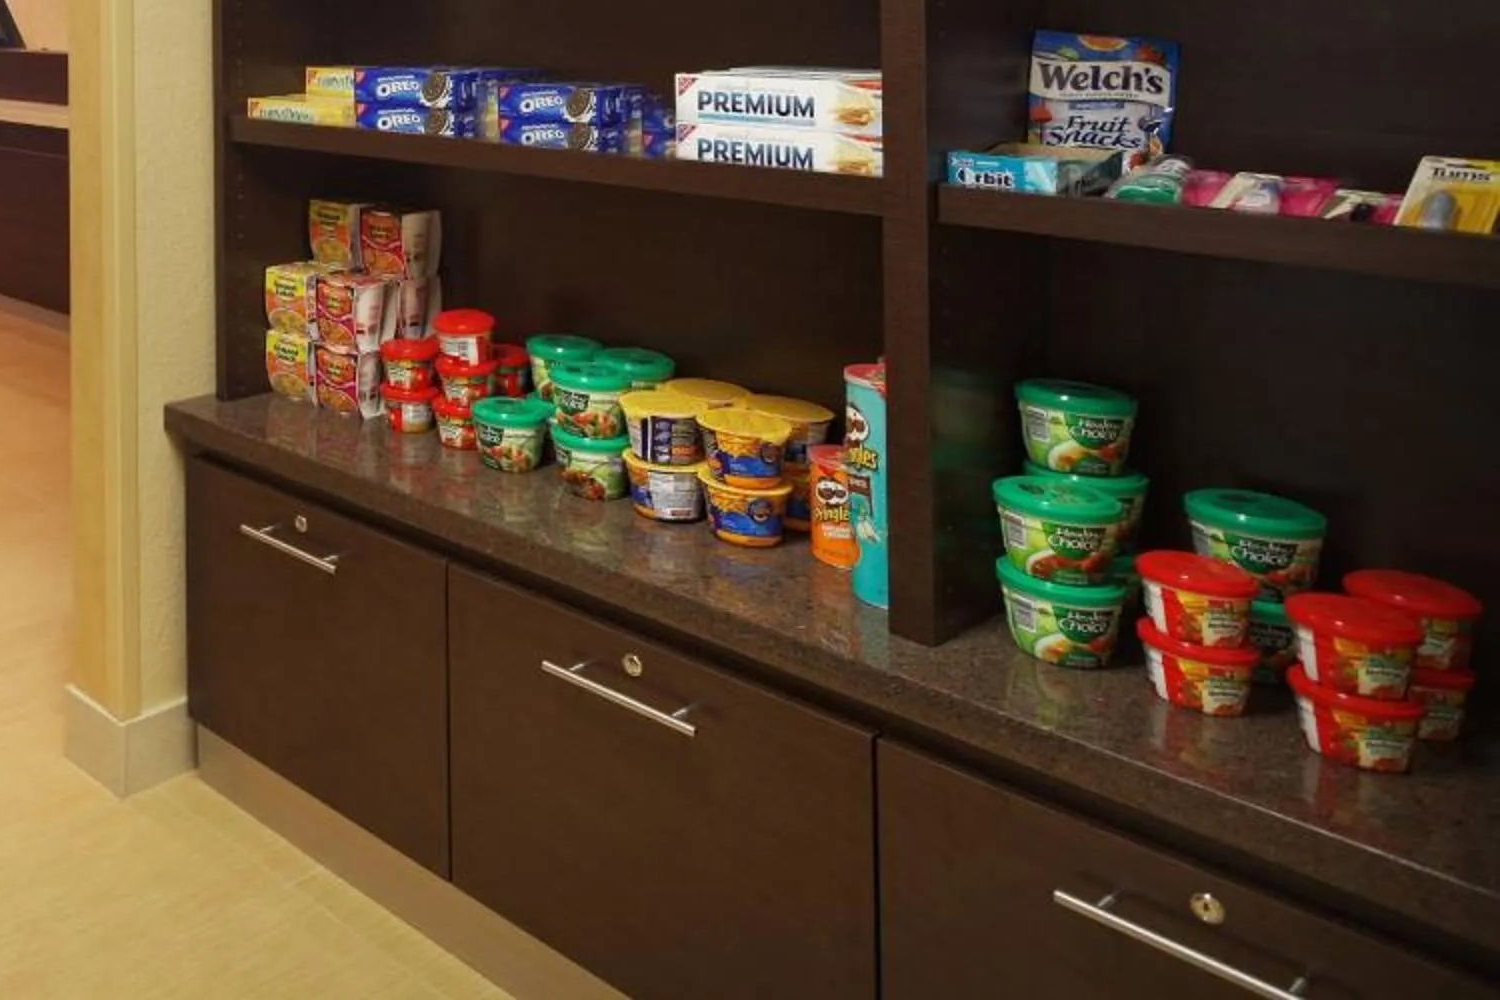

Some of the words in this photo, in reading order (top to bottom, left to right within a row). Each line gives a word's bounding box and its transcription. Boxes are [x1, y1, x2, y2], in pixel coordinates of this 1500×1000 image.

[1037, 61, 1164, 95] Welch's
[376, 81, 420, 98] OREO
[520, 95, 564, 113] OREO
[697, 90, 816, 118] PREMIUM
[376, 115, 421, 130] OREO
[1067, 115, 1131, 133] Fruit
[521, 129, 565, 145] OREO
[1046, 126, 1142, 149] Snacks
[697, 139, 814, 169] PREMIUM
[814, 505, 849, 524] Pringle
[1231, 546, 1289, 565] Choice
